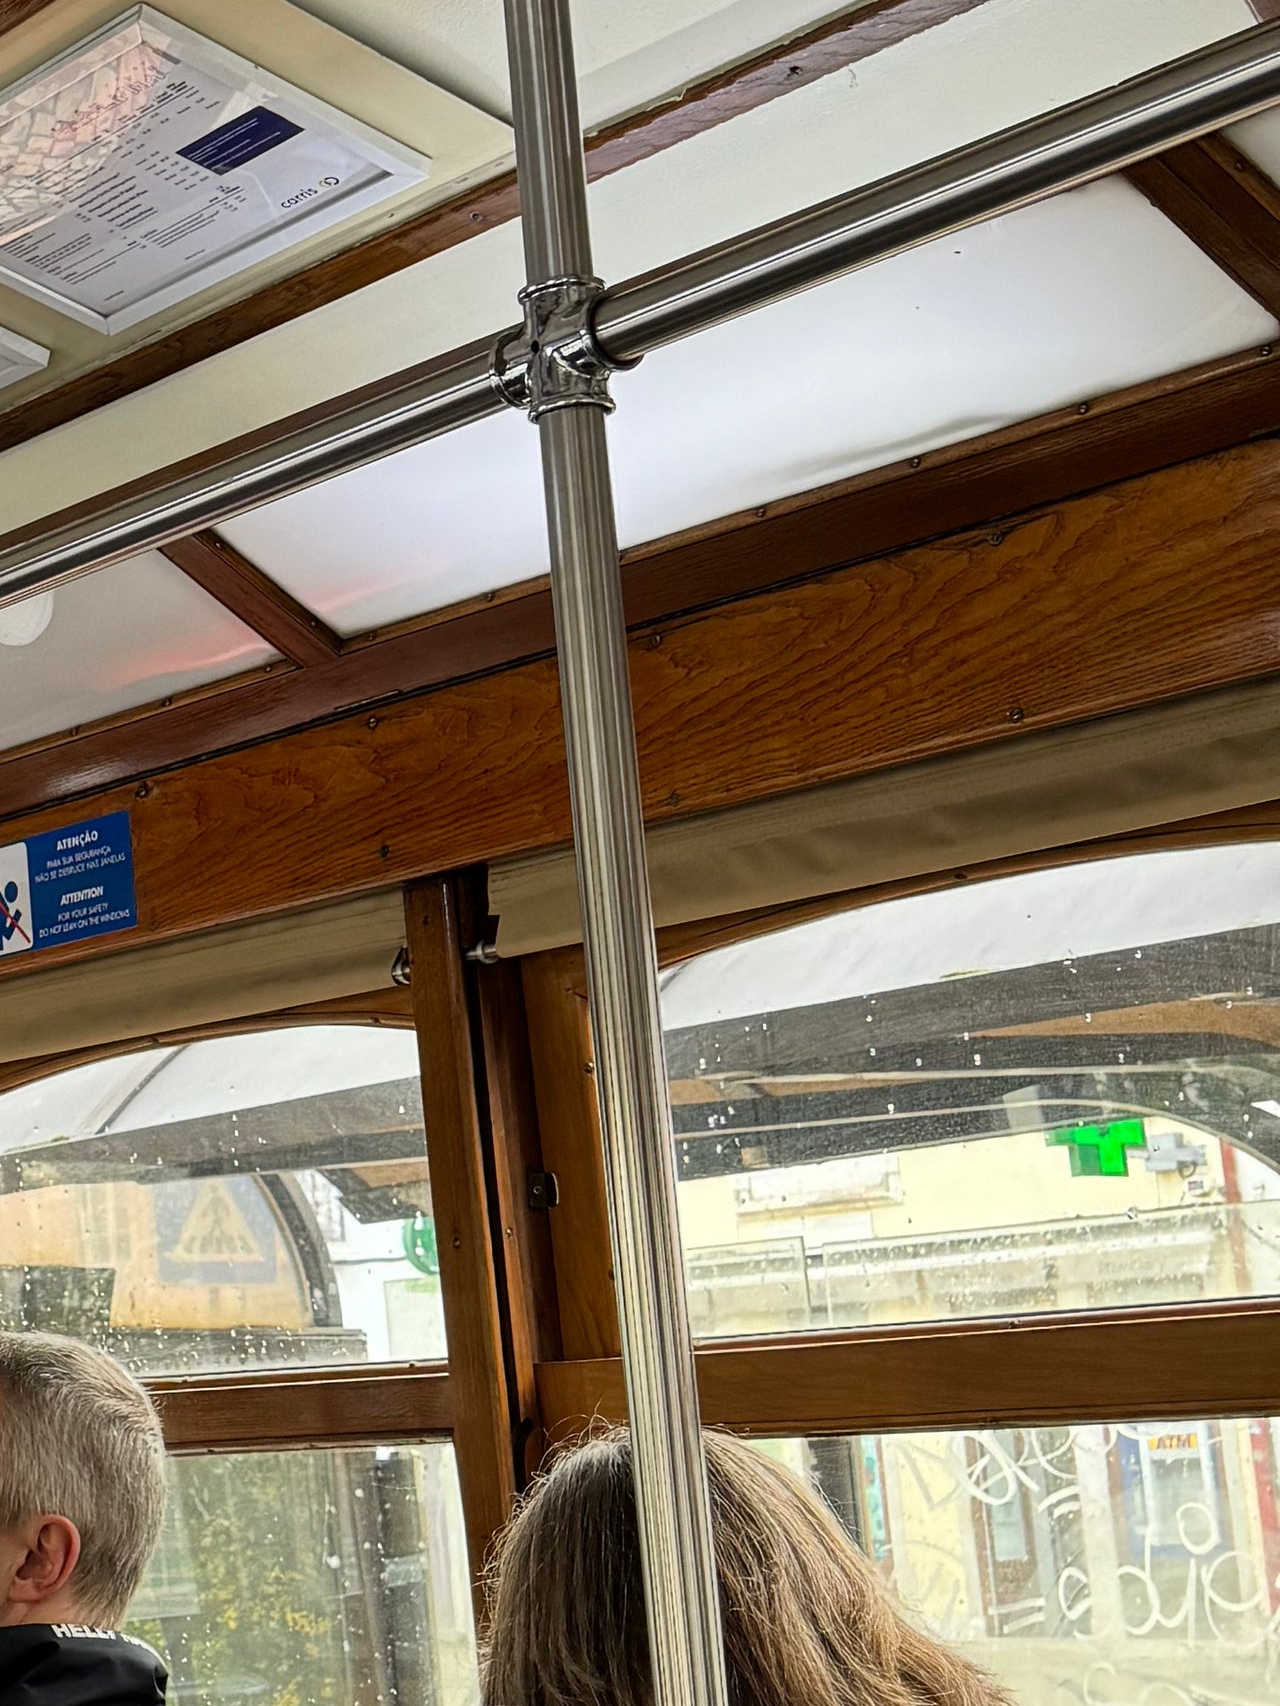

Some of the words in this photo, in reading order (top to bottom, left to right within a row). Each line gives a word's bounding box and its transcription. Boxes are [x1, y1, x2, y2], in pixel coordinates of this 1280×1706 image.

[281, 188, 318, 208] carris
[57, 830, 98, 851] ATENÇÃO
[60, 886, 104, 906] ATTENTION
